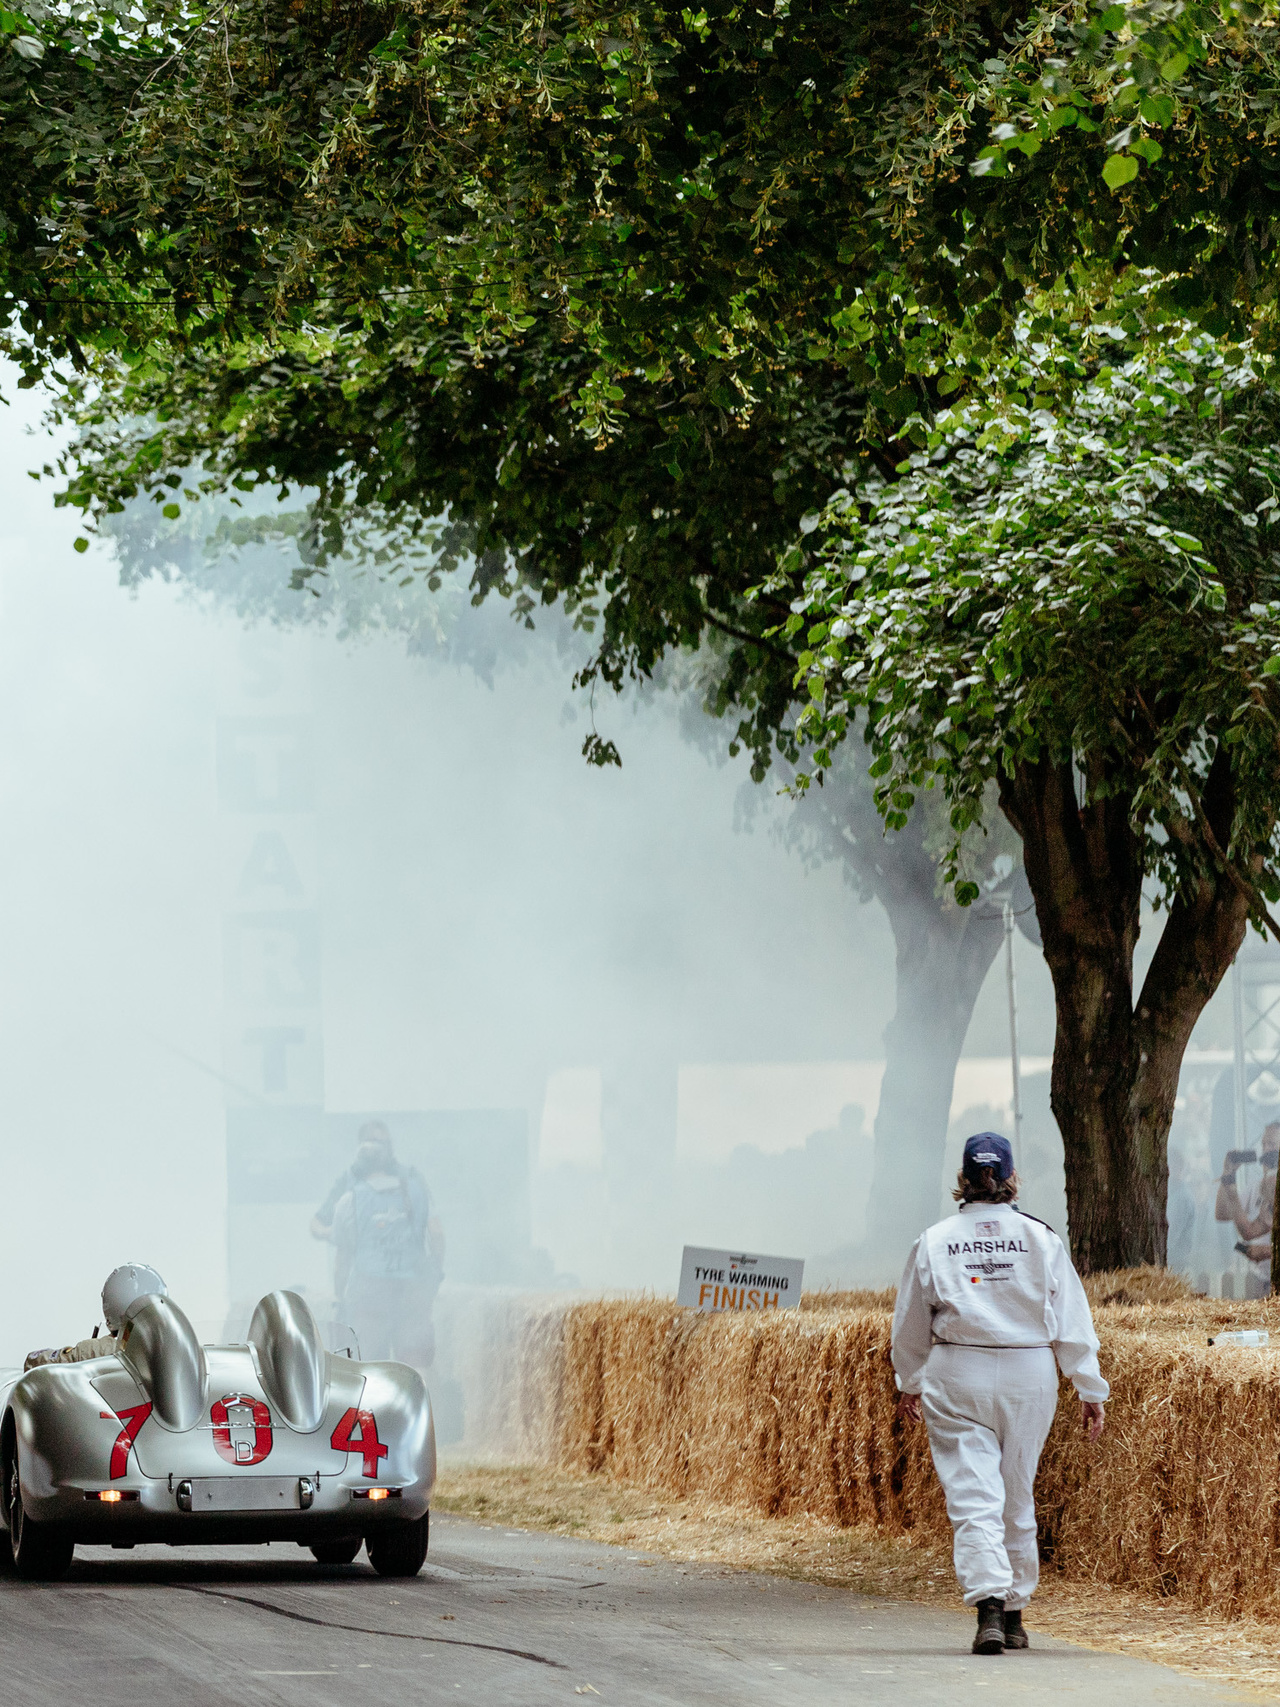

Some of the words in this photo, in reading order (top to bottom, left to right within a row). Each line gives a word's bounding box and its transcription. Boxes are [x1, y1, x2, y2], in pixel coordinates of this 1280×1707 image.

[947, 1240, 1029, 1256] MARSHAL
[694, 1266, 725, 1283] TYRE
[728, 1270, 789, 1290] WARMING
[698, 1283, 779, 1311] FINISH
[99, 1395, 389, 1481] 704
[234, 1440, 254, 1462] D
